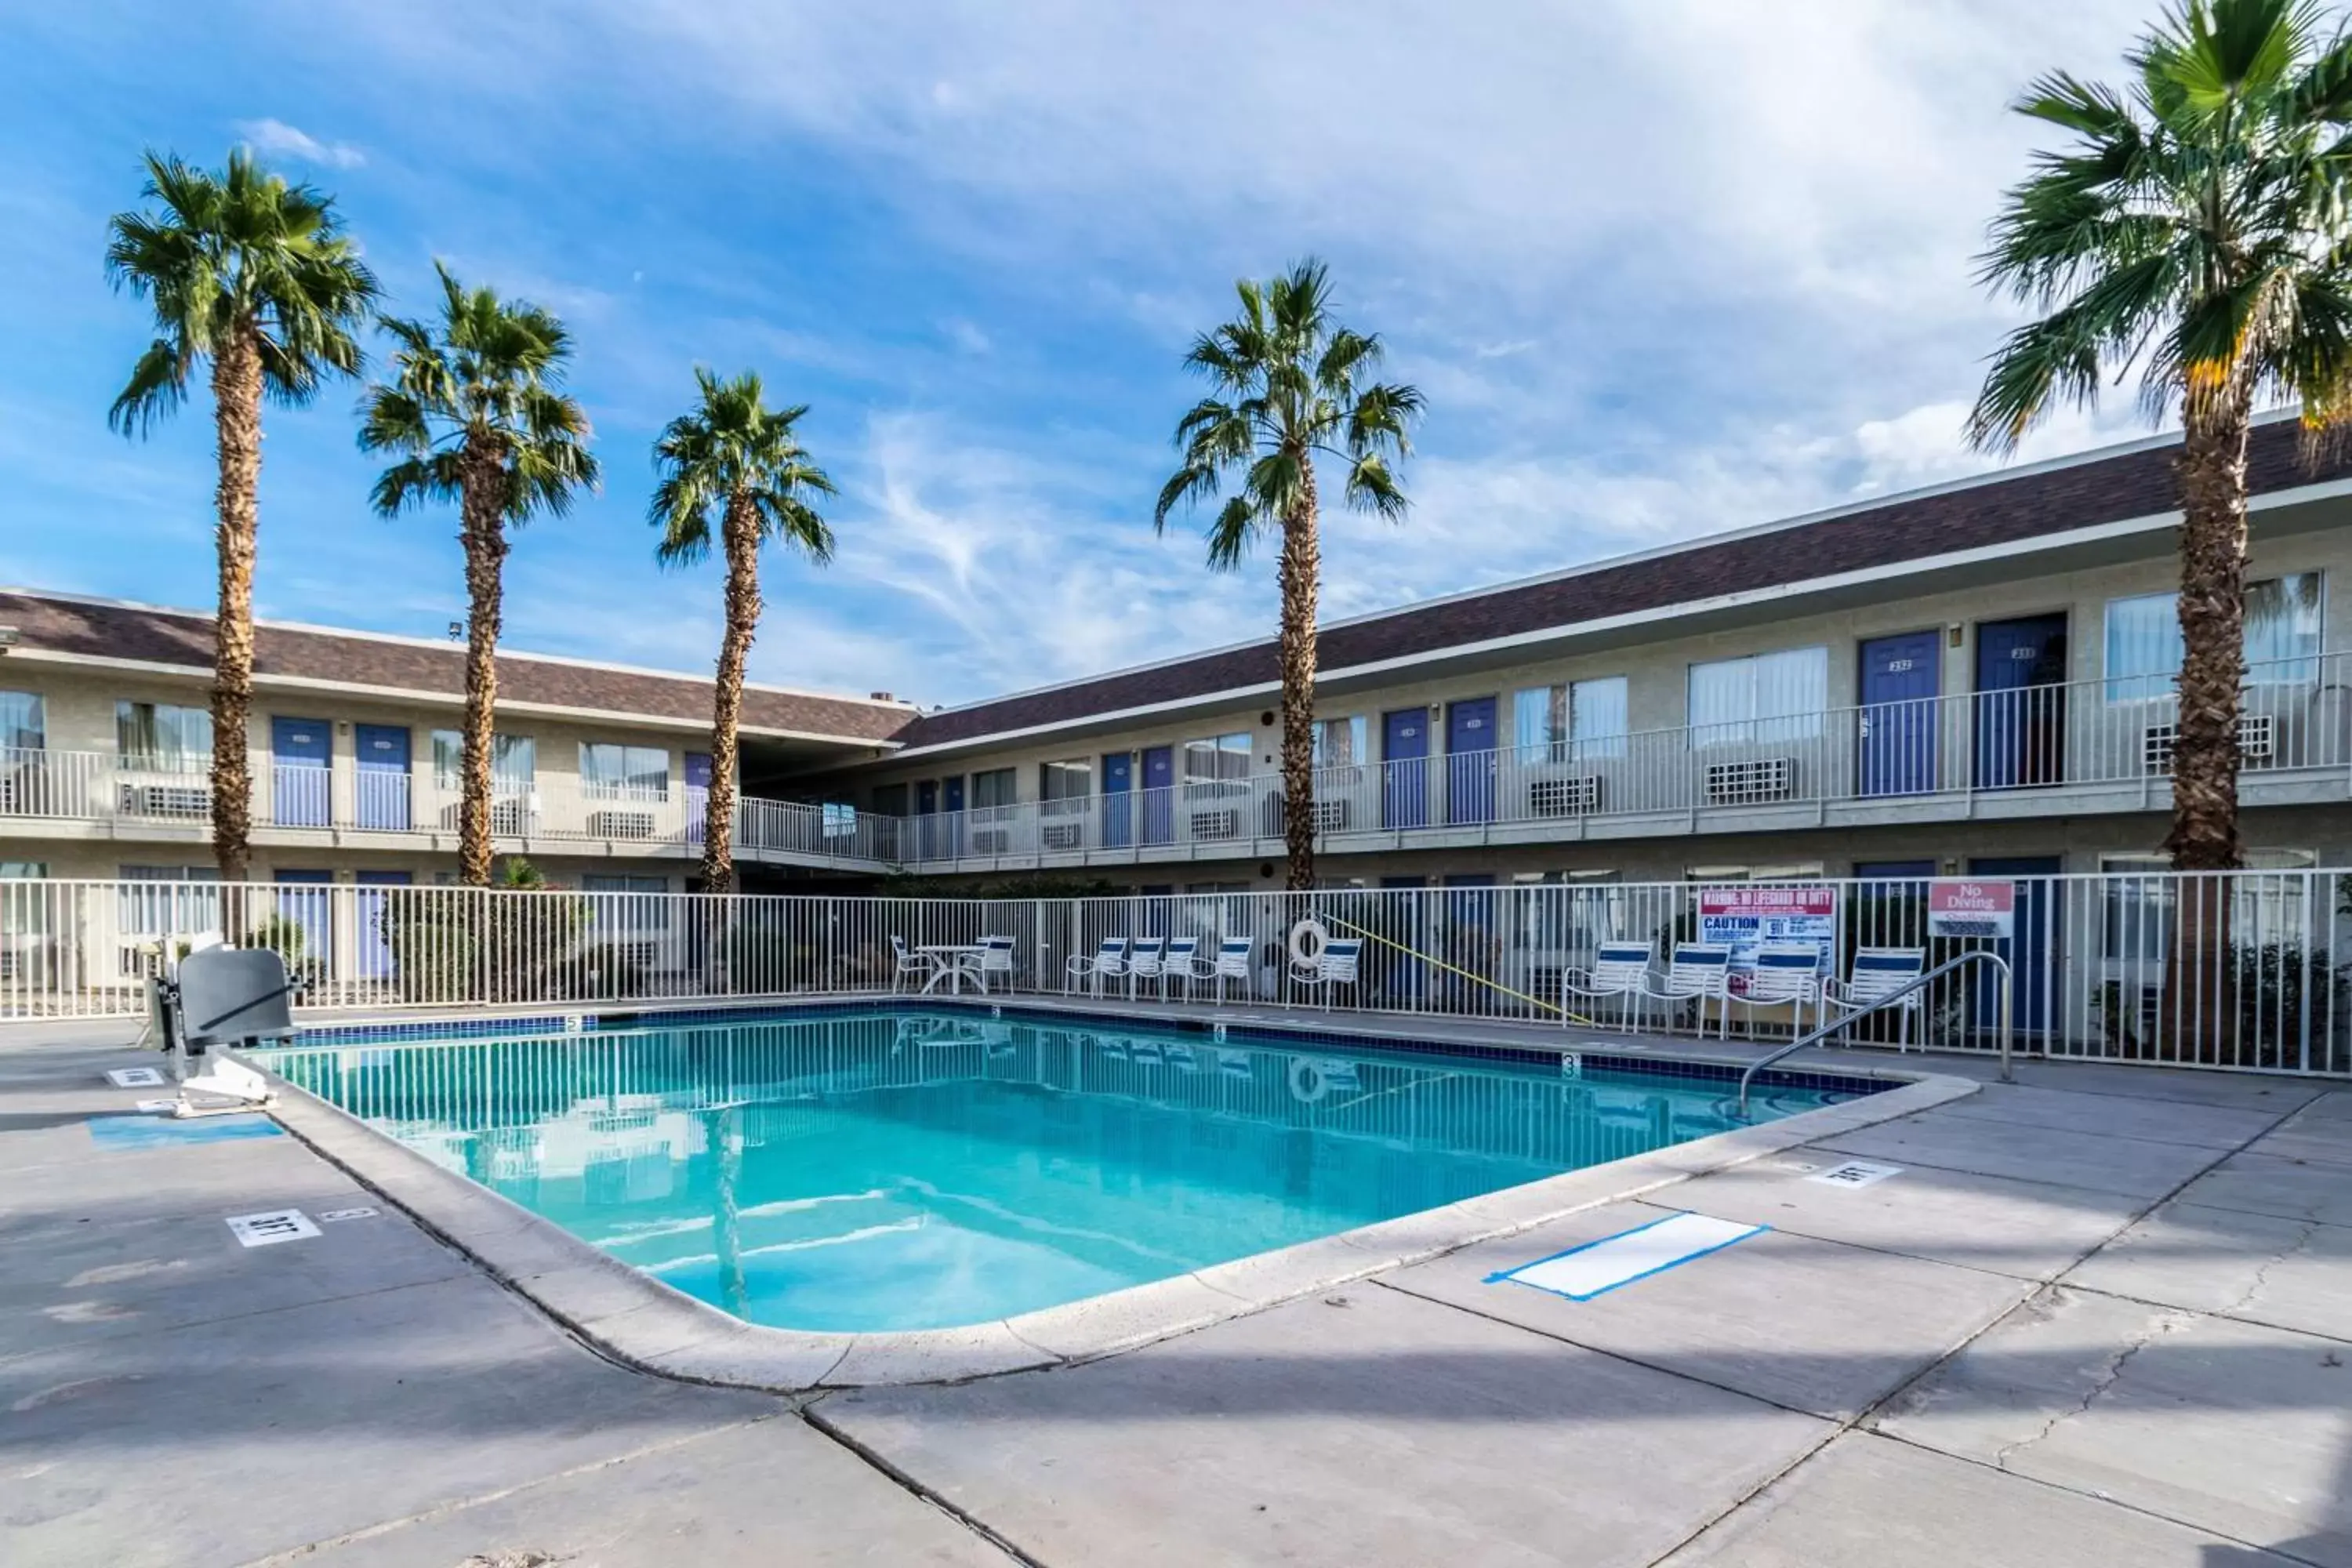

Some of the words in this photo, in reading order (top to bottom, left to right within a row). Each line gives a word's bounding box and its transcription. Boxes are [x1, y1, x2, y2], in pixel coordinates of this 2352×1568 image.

[1961, 884, 1982, 897] No
[1809, 891, 1831, 906] DUTY
[1947, 895, 1995, 910] Diving
[1704, 917, 1759, 929] CAUTION
